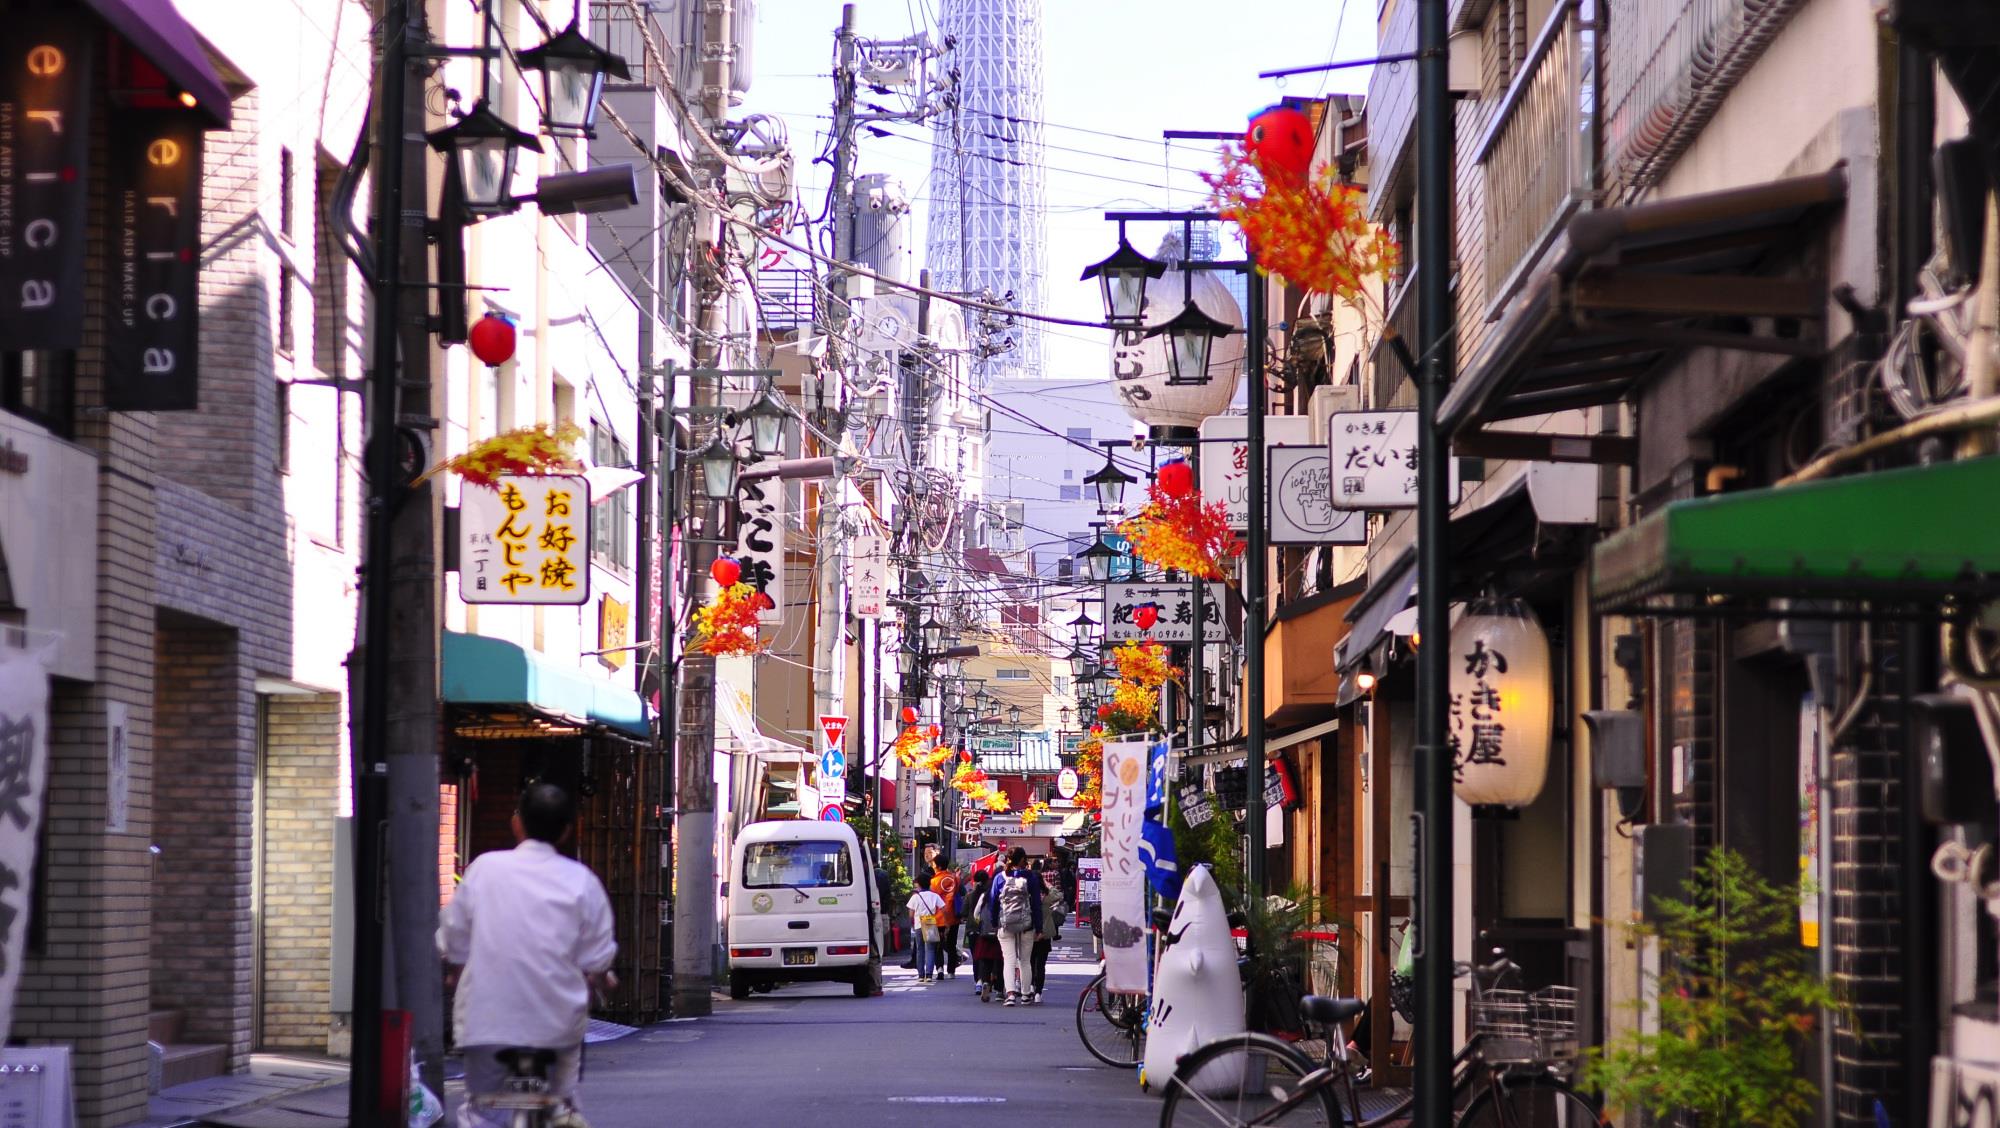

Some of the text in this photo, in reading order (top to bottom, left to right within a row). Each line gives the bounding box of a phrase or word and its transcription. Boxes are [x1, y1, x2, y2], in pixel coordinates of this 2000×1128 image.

[2, 102, 12, 139] HAIR
[1, 145, 11, 177] AND
[21, 45, 77, 308] erica
[125, 190, 136, 224] HAIR
[124, 228, 135, 257] AND
[143, 138, 192, 374] erica
[1345, 420, 1387, 435] かき屋
[1344, 443, 1419, 471] だいま
[538, 489, 577, 592] お好焼
[1464, 639, 1509, 767] かき屋
[825, 721, 843, 730] 止まれ
